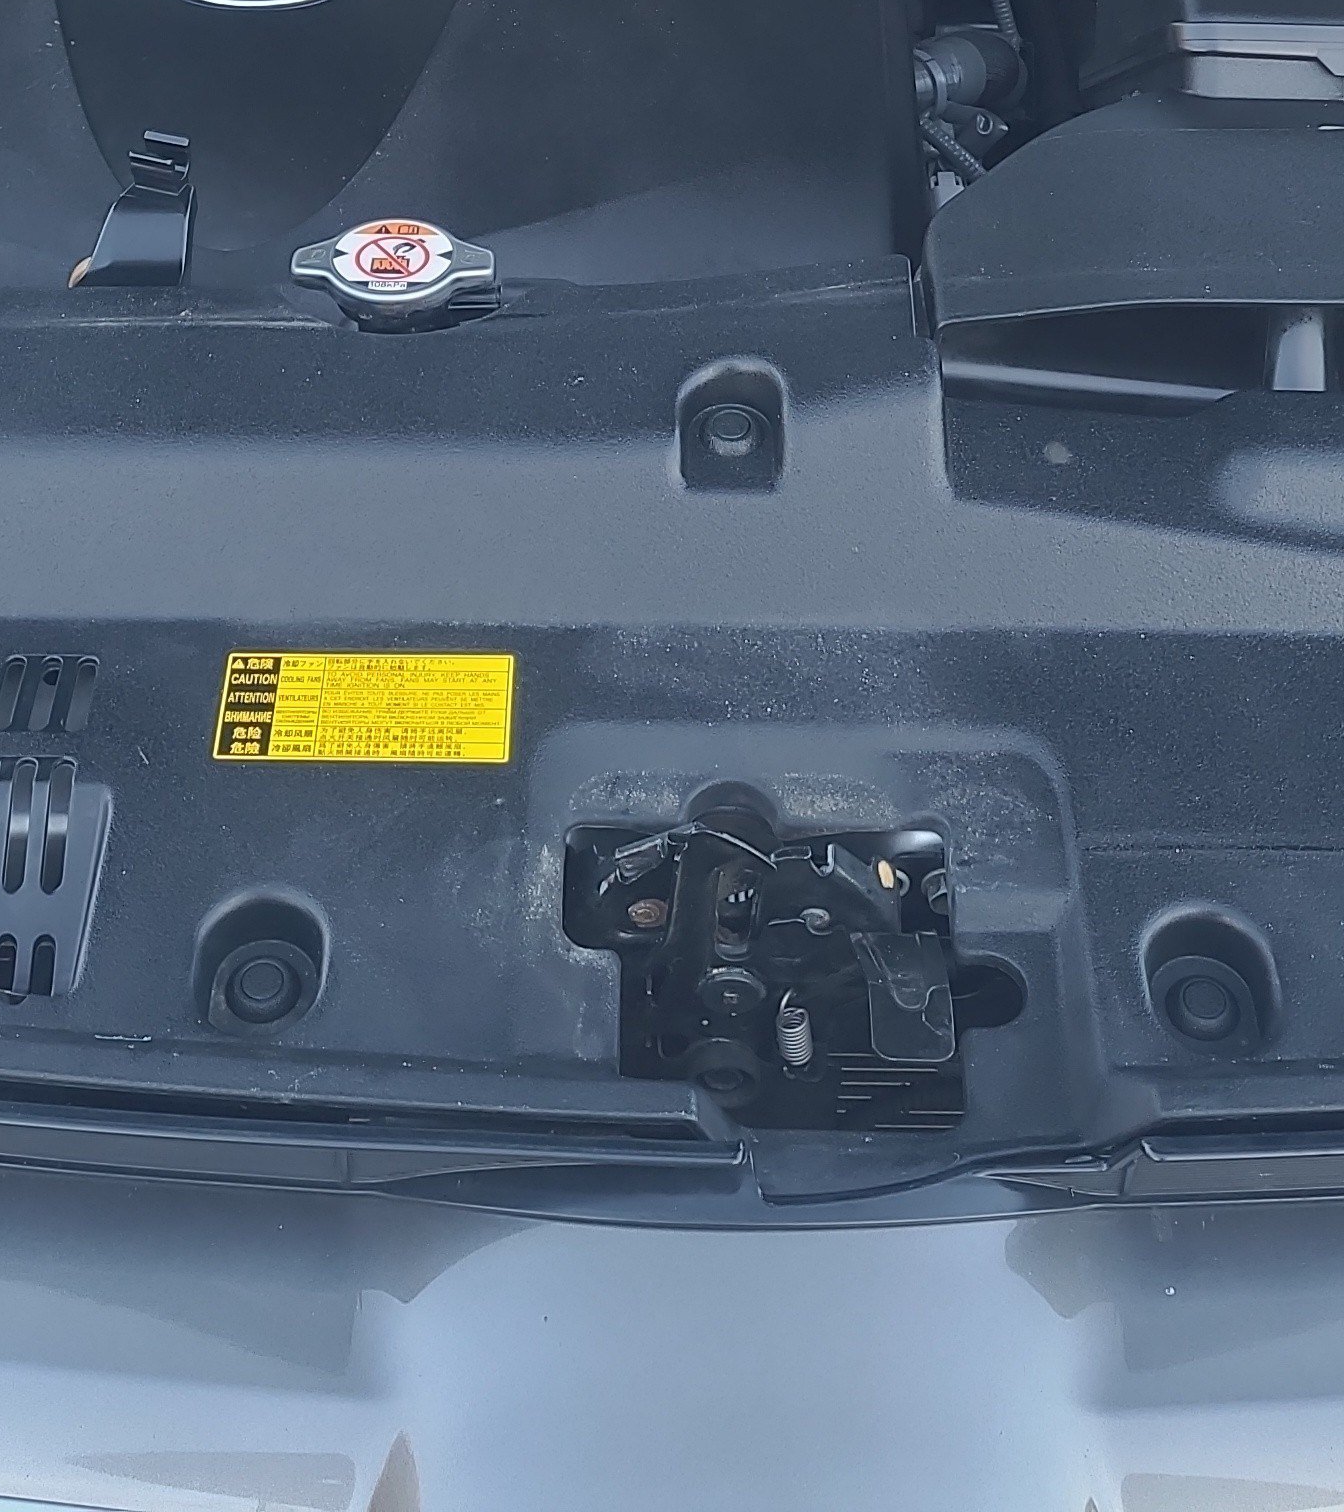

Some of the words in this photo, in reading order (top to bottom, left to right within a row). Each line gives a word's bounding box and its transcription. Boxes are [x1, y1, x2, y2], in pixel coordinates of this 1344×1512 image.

[231, 673, 278, 685] CAUTION
[228, 691, 276, 704] ATTENTION
[278, 694, 319, 702] VENTILATEURS
[224, 710, 273, 723] ВНИМАНИЕ
